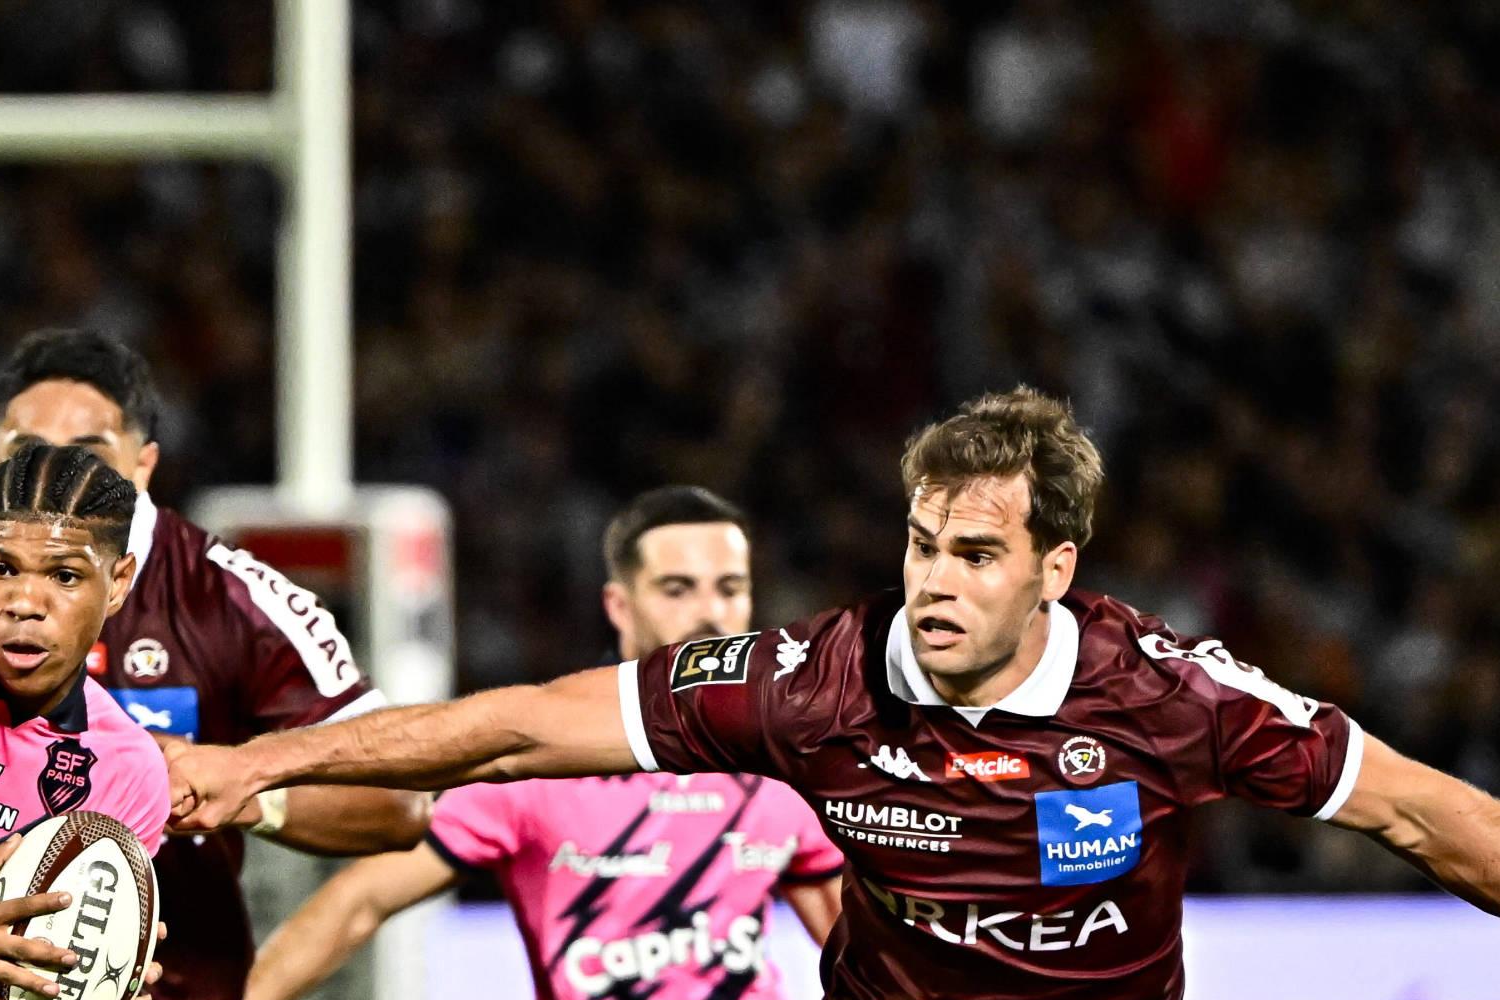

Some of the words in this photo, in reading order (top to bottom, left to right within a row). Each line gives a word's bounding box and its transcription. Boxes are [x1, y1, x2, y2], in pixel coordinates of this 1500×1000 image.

[54, 750, 86, 772] SF
[46, 769, 86, 787] PARIS
[825, 800, 963, 833] HUMBLOT
[838, 827, 950, 853] EXPERIENCES
[1046, 833, 1137, 860] HUMAN
[1058, 856, 1127, 873] Immobilier
[564, 910, 764, 995] Capri-S
